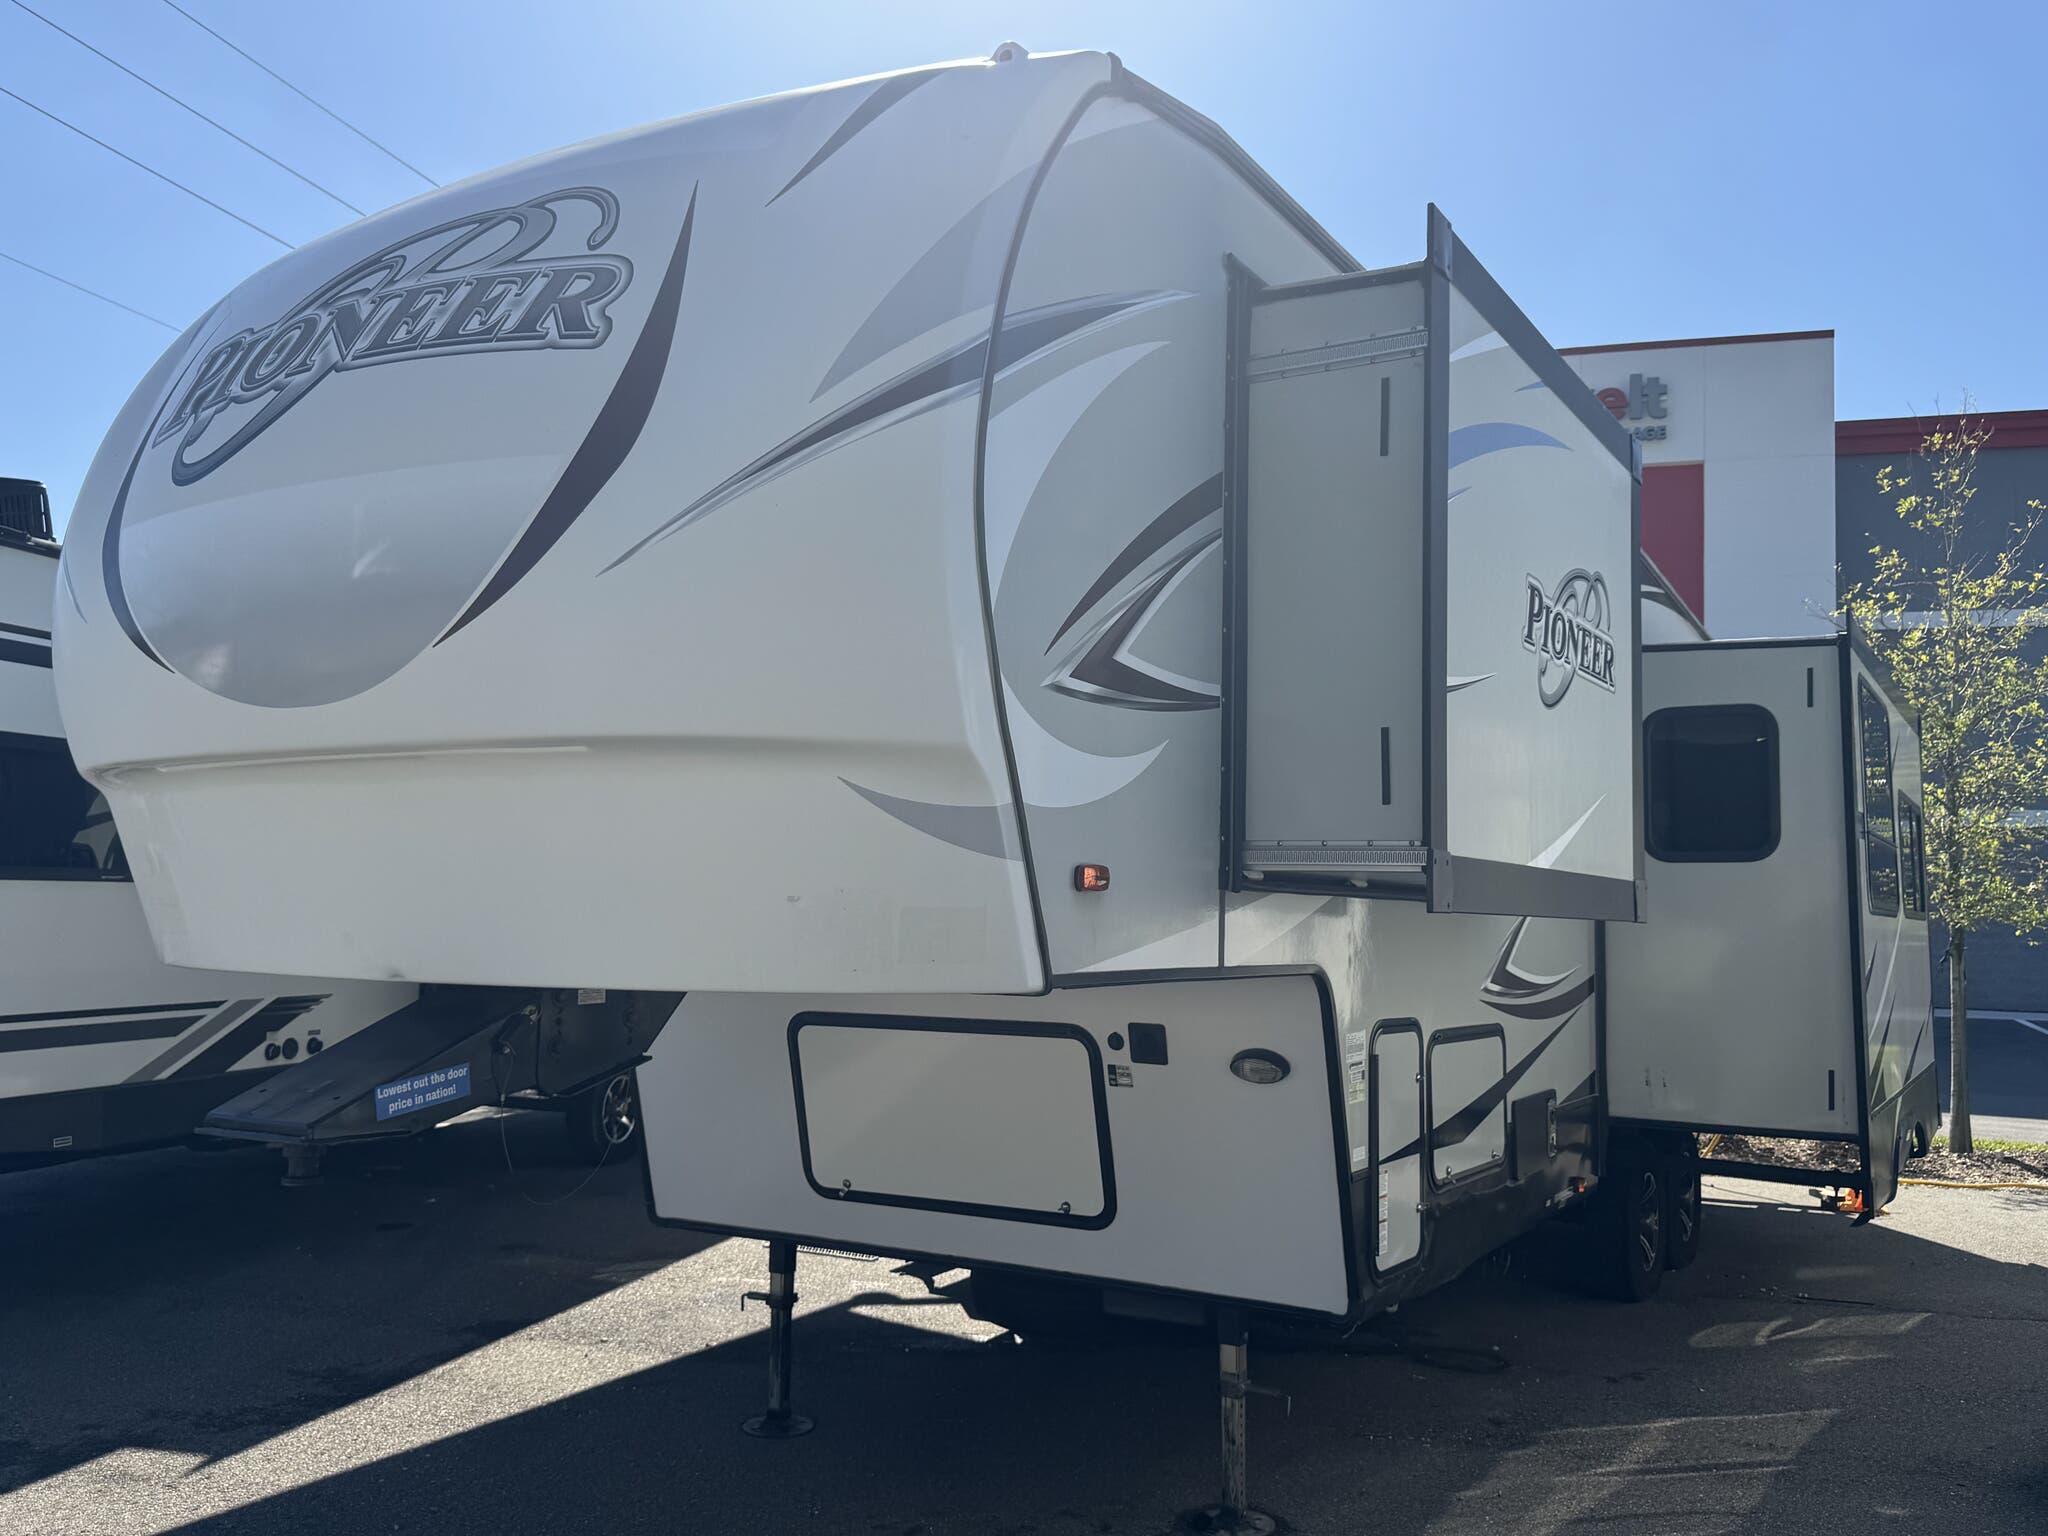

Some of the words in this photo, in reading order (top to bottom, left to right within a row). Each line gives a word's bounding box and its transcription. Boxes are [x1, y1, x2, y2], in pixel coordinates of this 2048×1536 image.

[153, 257, 633, 446] PIONEER
[1595, 373, 1668, 420] elt
[1632, 425, 1667, 441] AGE
[1522, 577, 1616, 690] PIONEER
[377, 1081, 412, 1099] Lowest
[413, 1077, 429, 1089] out
[430, 1073, 446, 1085] the
[447, 1067, 468, 1080] door
[388, 1097, 413, 1114] price
[414, 1094, 424, 1105] in
[425, 1083, 457, 1102] nation!
